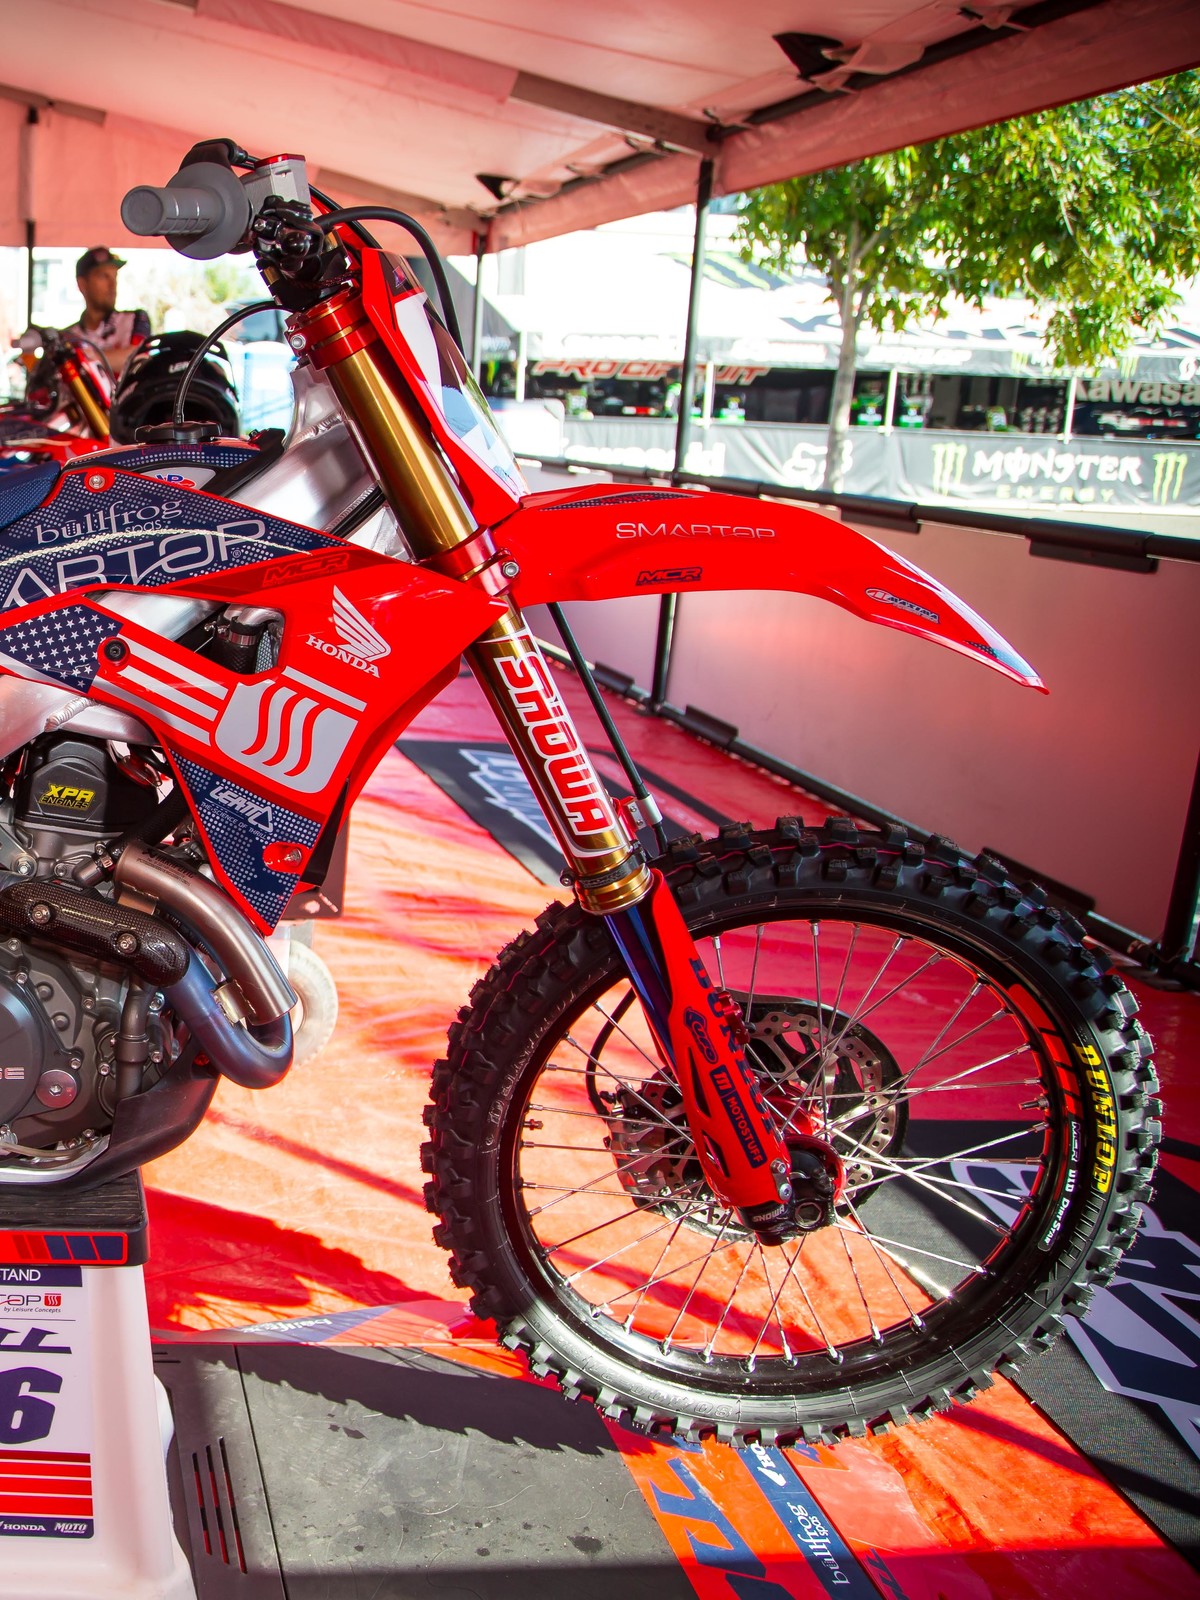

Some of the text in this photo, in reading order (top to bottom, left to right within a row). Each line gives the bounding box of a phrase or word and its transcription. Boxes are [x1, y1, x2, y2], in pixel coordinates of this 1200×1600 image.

[972, 446, 1144, 486] MONSTER
[124, 519, 163, 538] spas
[615, 522, 777, 540] SMARTOP
[635, 567, 703, 586] MCR
[306, 635, 381, 678] HONDA
[494, 651, 614, 836] SHOWA
[48, 784, 96, 803] XPR
[39, 796, 91, 811] ENGINES
[237, 820, 248, 830] OF
[726, 1096, 765, 1164] MOTOSTUFF
[1071, 1121, 1082, 1163] MCR
[753, 1204, 786, 1222] SHOWA
[3, 1306, 12, 1314] by
[3, 1523, 46, 1532] HONDA
[53, 1521, 88, 1533] MOTO
